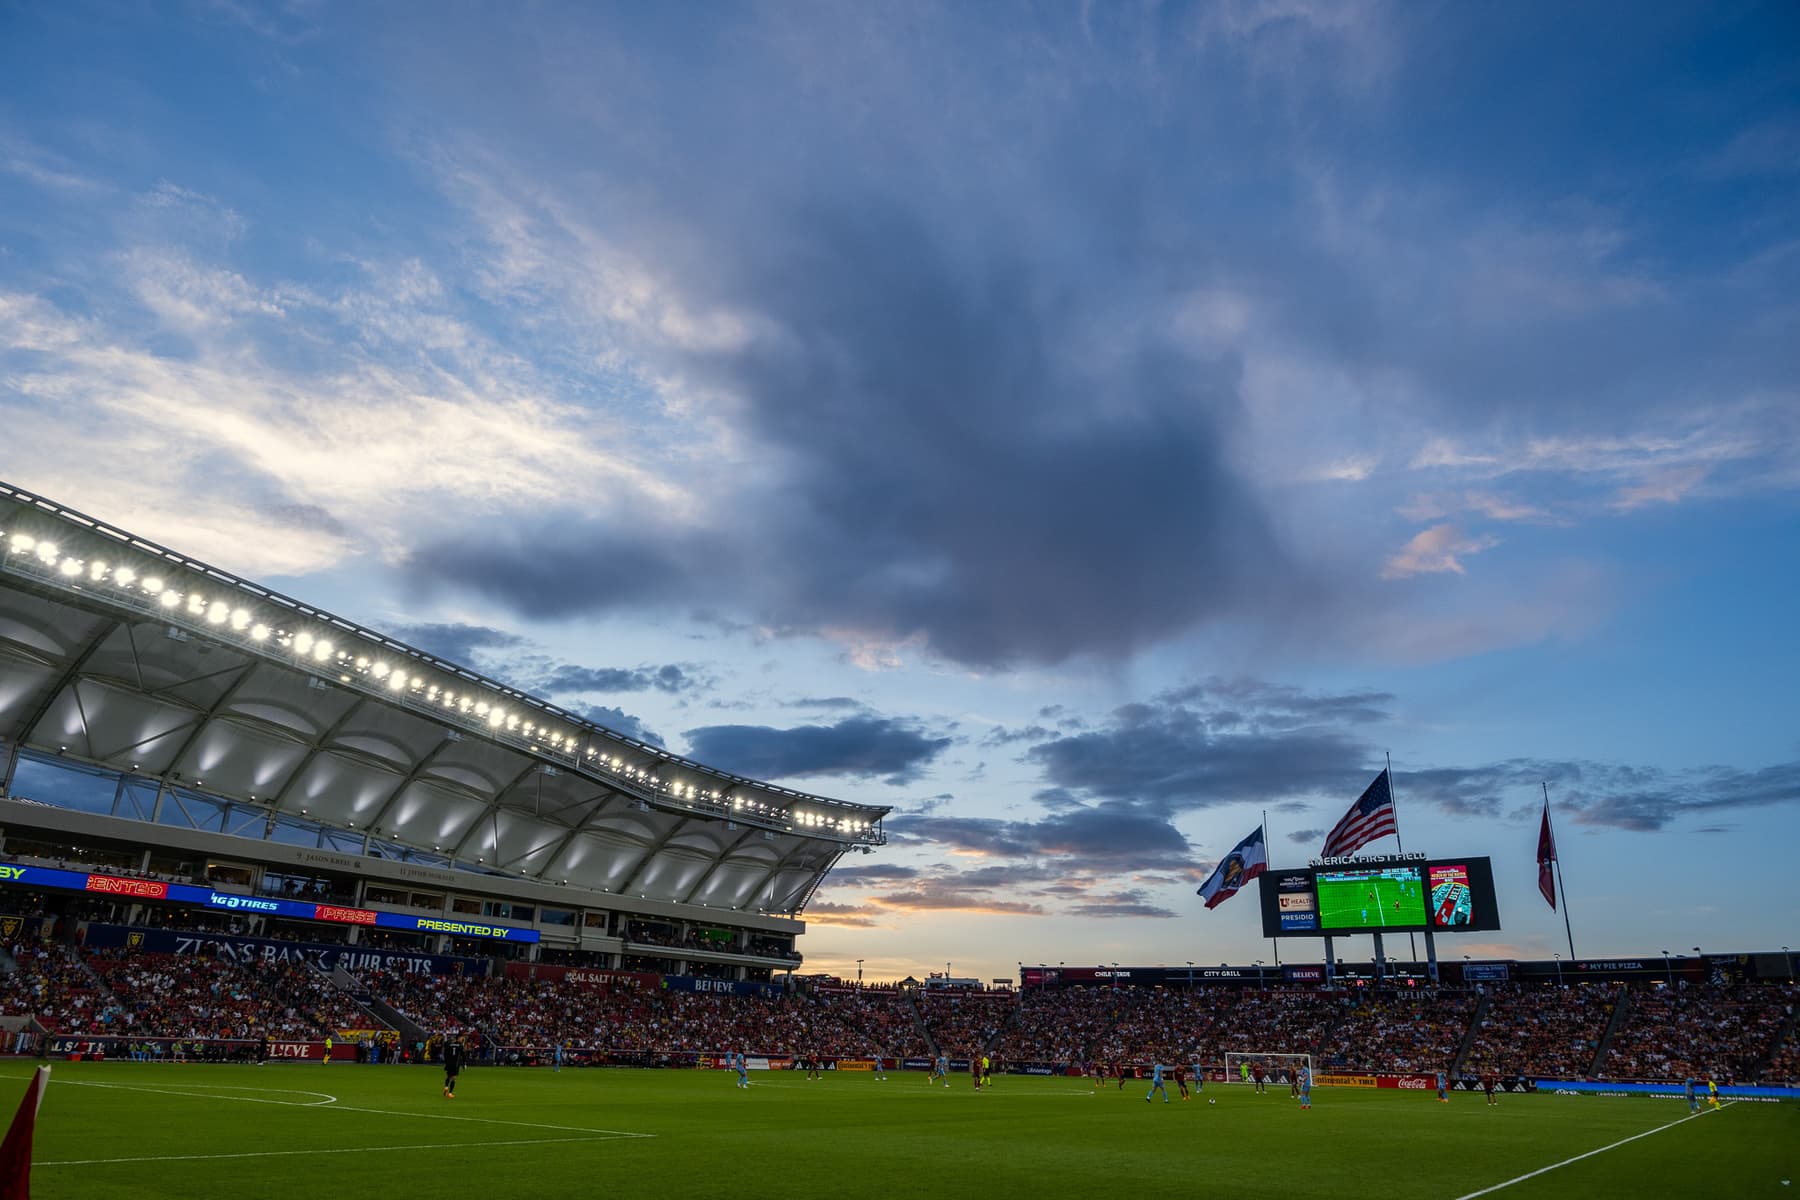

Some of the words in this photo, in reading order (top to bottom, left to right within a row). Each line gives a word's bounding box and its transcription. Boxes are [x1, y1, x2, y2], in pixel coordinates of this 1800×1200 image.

[1309, 855, 1355, 866] AMERICA
[1358, 852, 1391, 863] FIRST
[1395, 852, 1425, 862] FIELD
[240, 899, 277, 911] TIRES
[1281, 913, 1314, 921] PRESIDIO
[417, 919, 490, 936] PRESENTED
[491, 928, 508, 938] BY
[1395, 990, 1437, 1001] BELIEVE
[453, 1047, 457, 1056] 1
